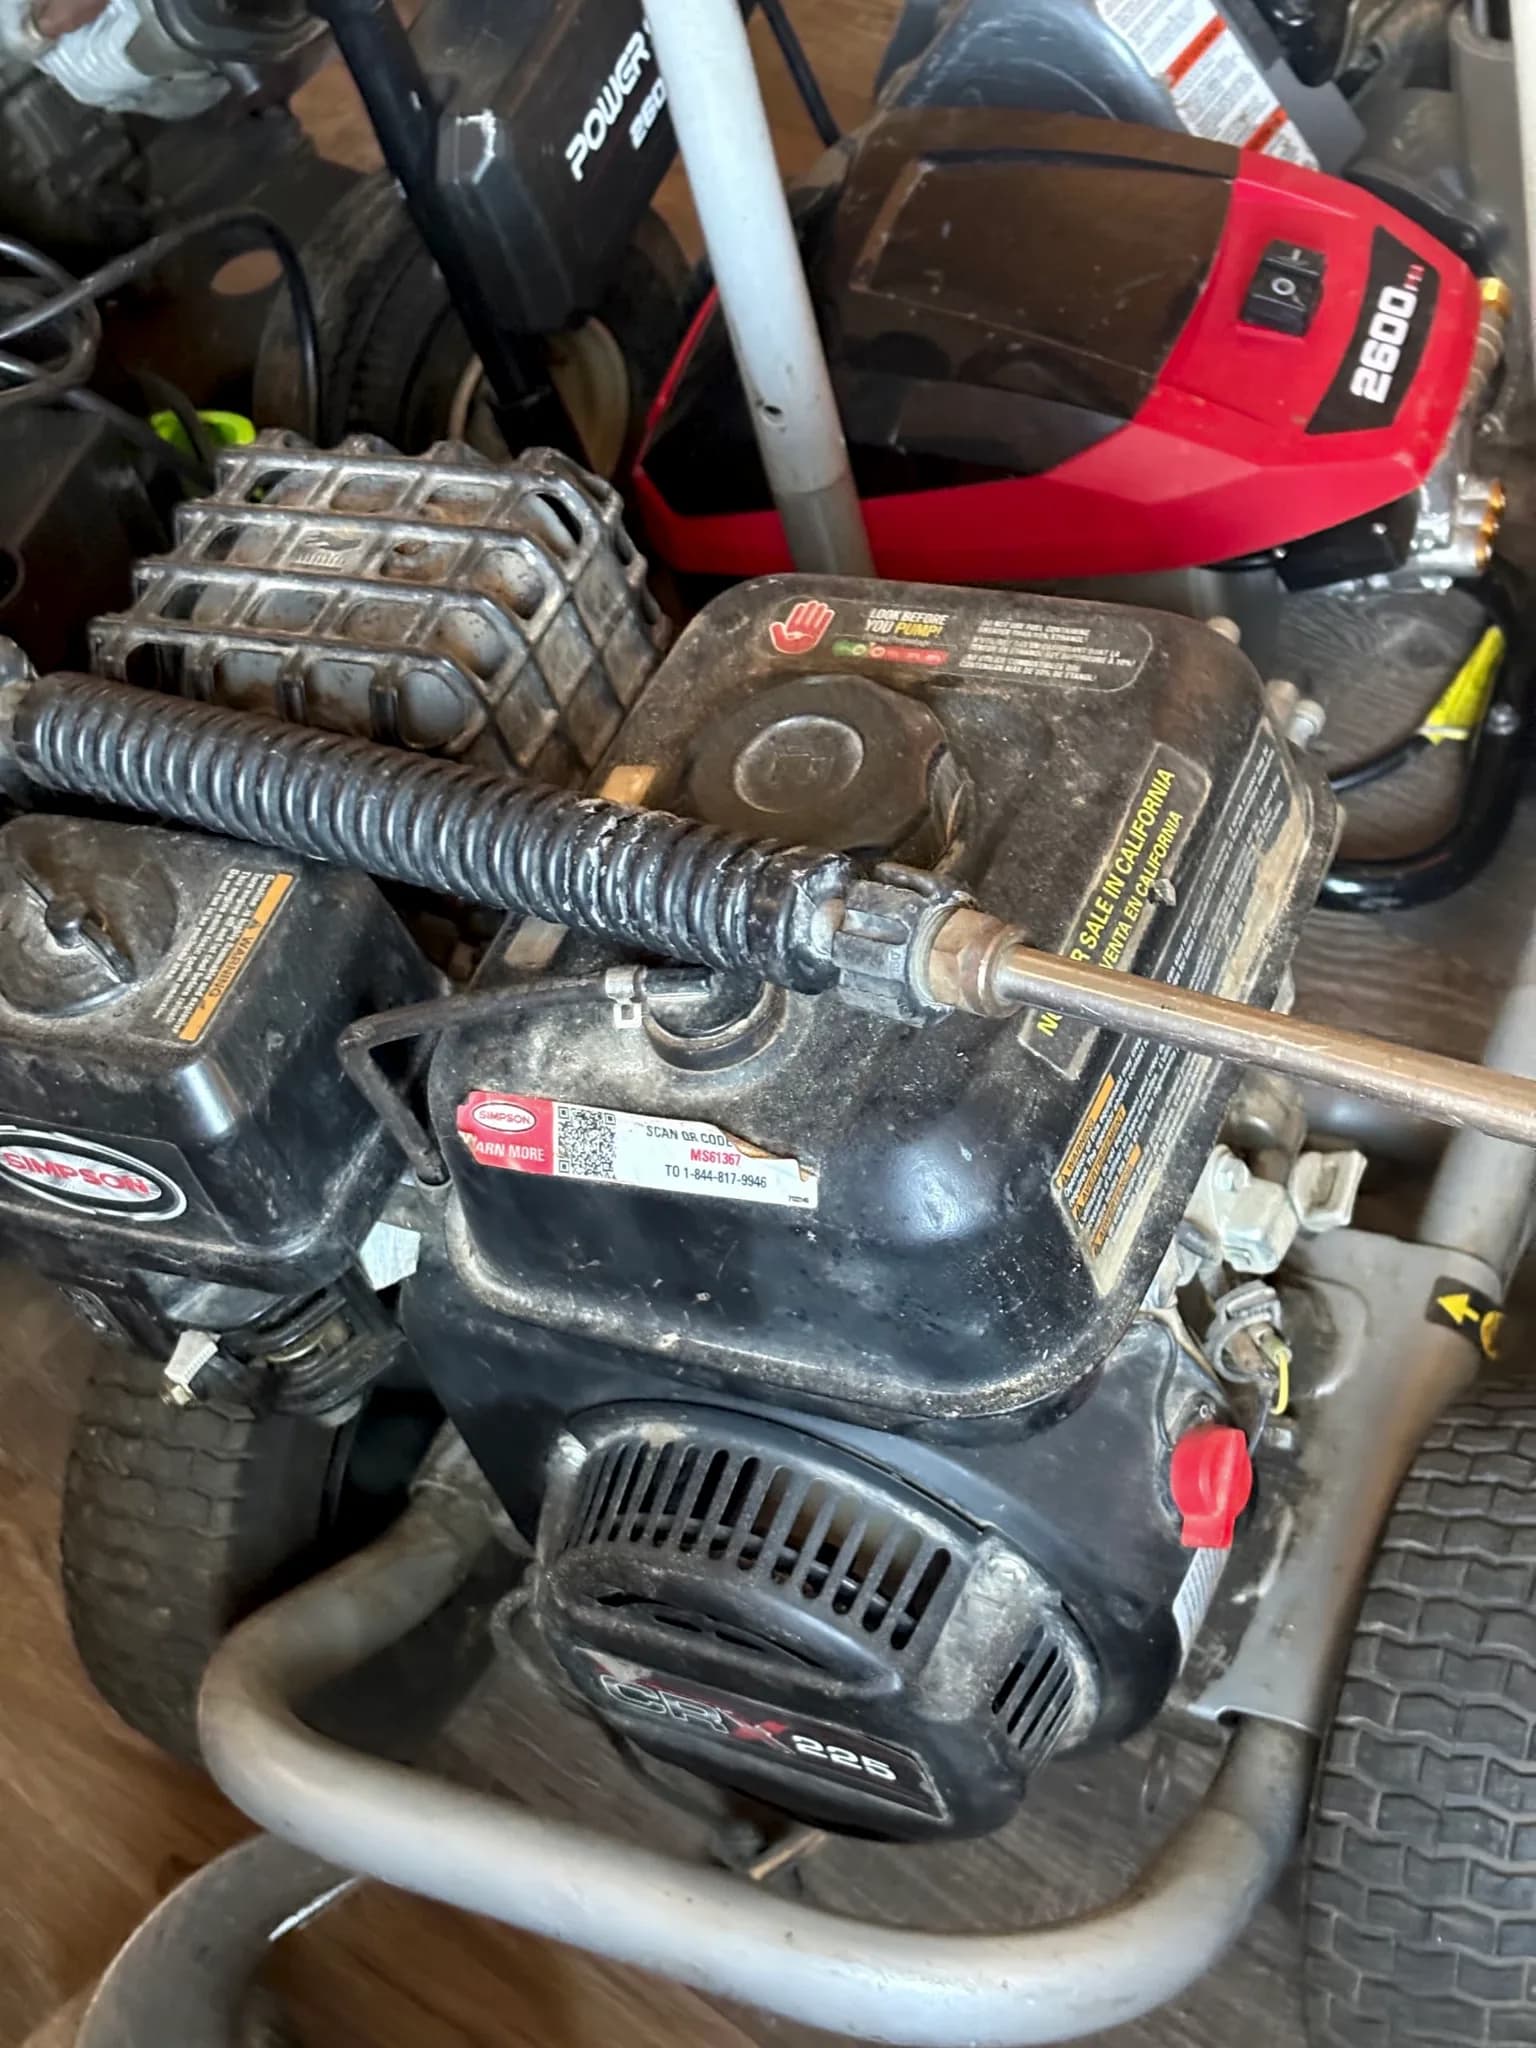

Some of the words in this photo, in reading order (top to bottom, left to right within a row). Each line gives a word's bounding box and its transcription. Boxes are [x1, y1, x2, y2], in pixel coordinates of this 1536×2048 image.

[1349, 286, 1418, 403] 2600
[864, 618, 894, 633] YOU
[893, 620, 944, 638] PUMP!
[869, 607, 903, 621] LOOK
[900, 610, 948, 625] BEFORE
[1111, 767, 1177, 875] CALIFORNIA
[1132, 810, 1184, 897] CALIFORNIA
[1101, 871, 1125, 899] IN
[1077, 895, 1114, 949] SALE
[1122, 893, 1143, 921] EN
[207, 934, 254, 997] WARNING
[1098, 921, 1133, 969] VENTA
[478, 1110, 530, 1125] SIMPSON
[645, 1125, 678, 1139] SCAN
[681, 1131, 698, 1142] QR
[509, 1145, 545, 1161] MORE
[690, 1149, 740, 1166] MS61367
[1065, 1117, 1095, 1171] WARNING
[1079, 1109, 1126, 1201] AVERTISSEMENT
[2, 1152, 149, 1195] SIMPSON
[664, 1165, 680, 1176] TO
[683, 1167, 767, 1188] 1-844-817-9946
[793, 1734, 895, 1782] 225
